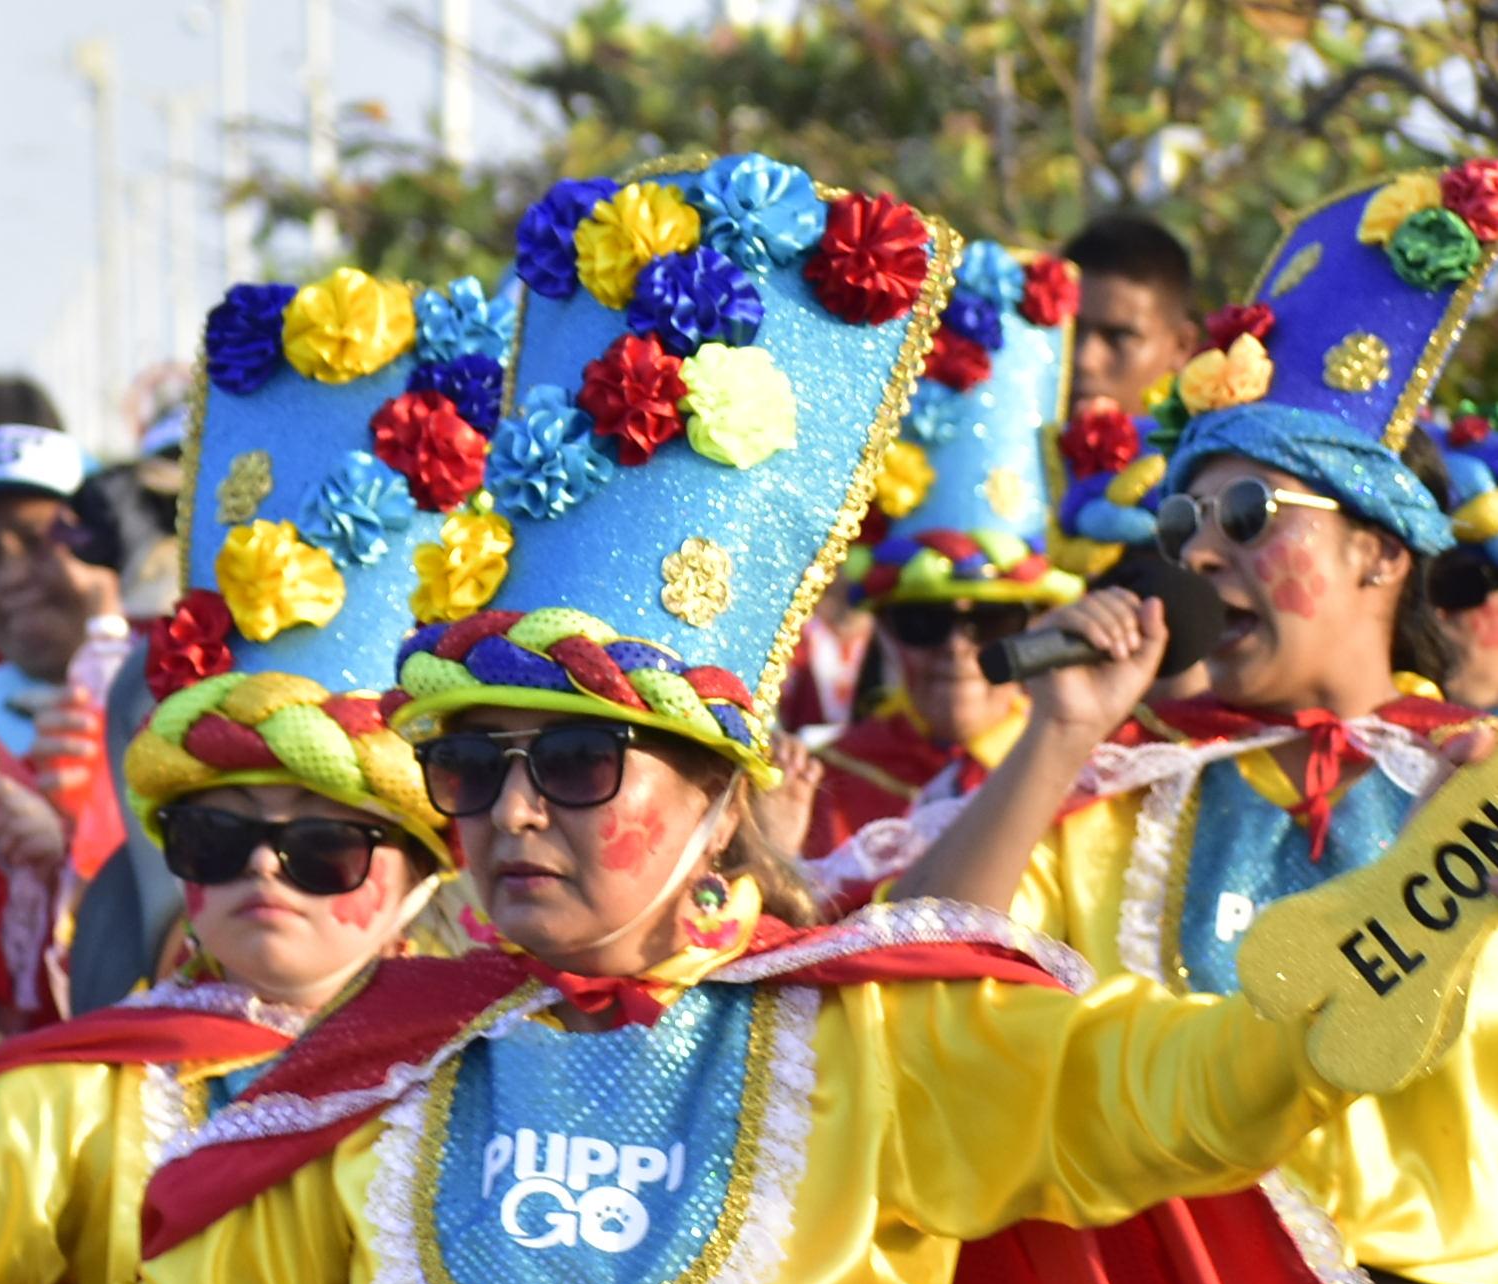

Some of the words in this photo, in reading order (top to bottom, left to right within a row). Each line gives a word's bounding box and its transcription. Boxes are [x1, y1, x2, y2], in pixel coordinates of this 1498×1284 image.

[1338, 917, 1425, 996] EL
[482, 1127, 686, 1199] PUPPI
[500, 1178, 650, 1253] GO
